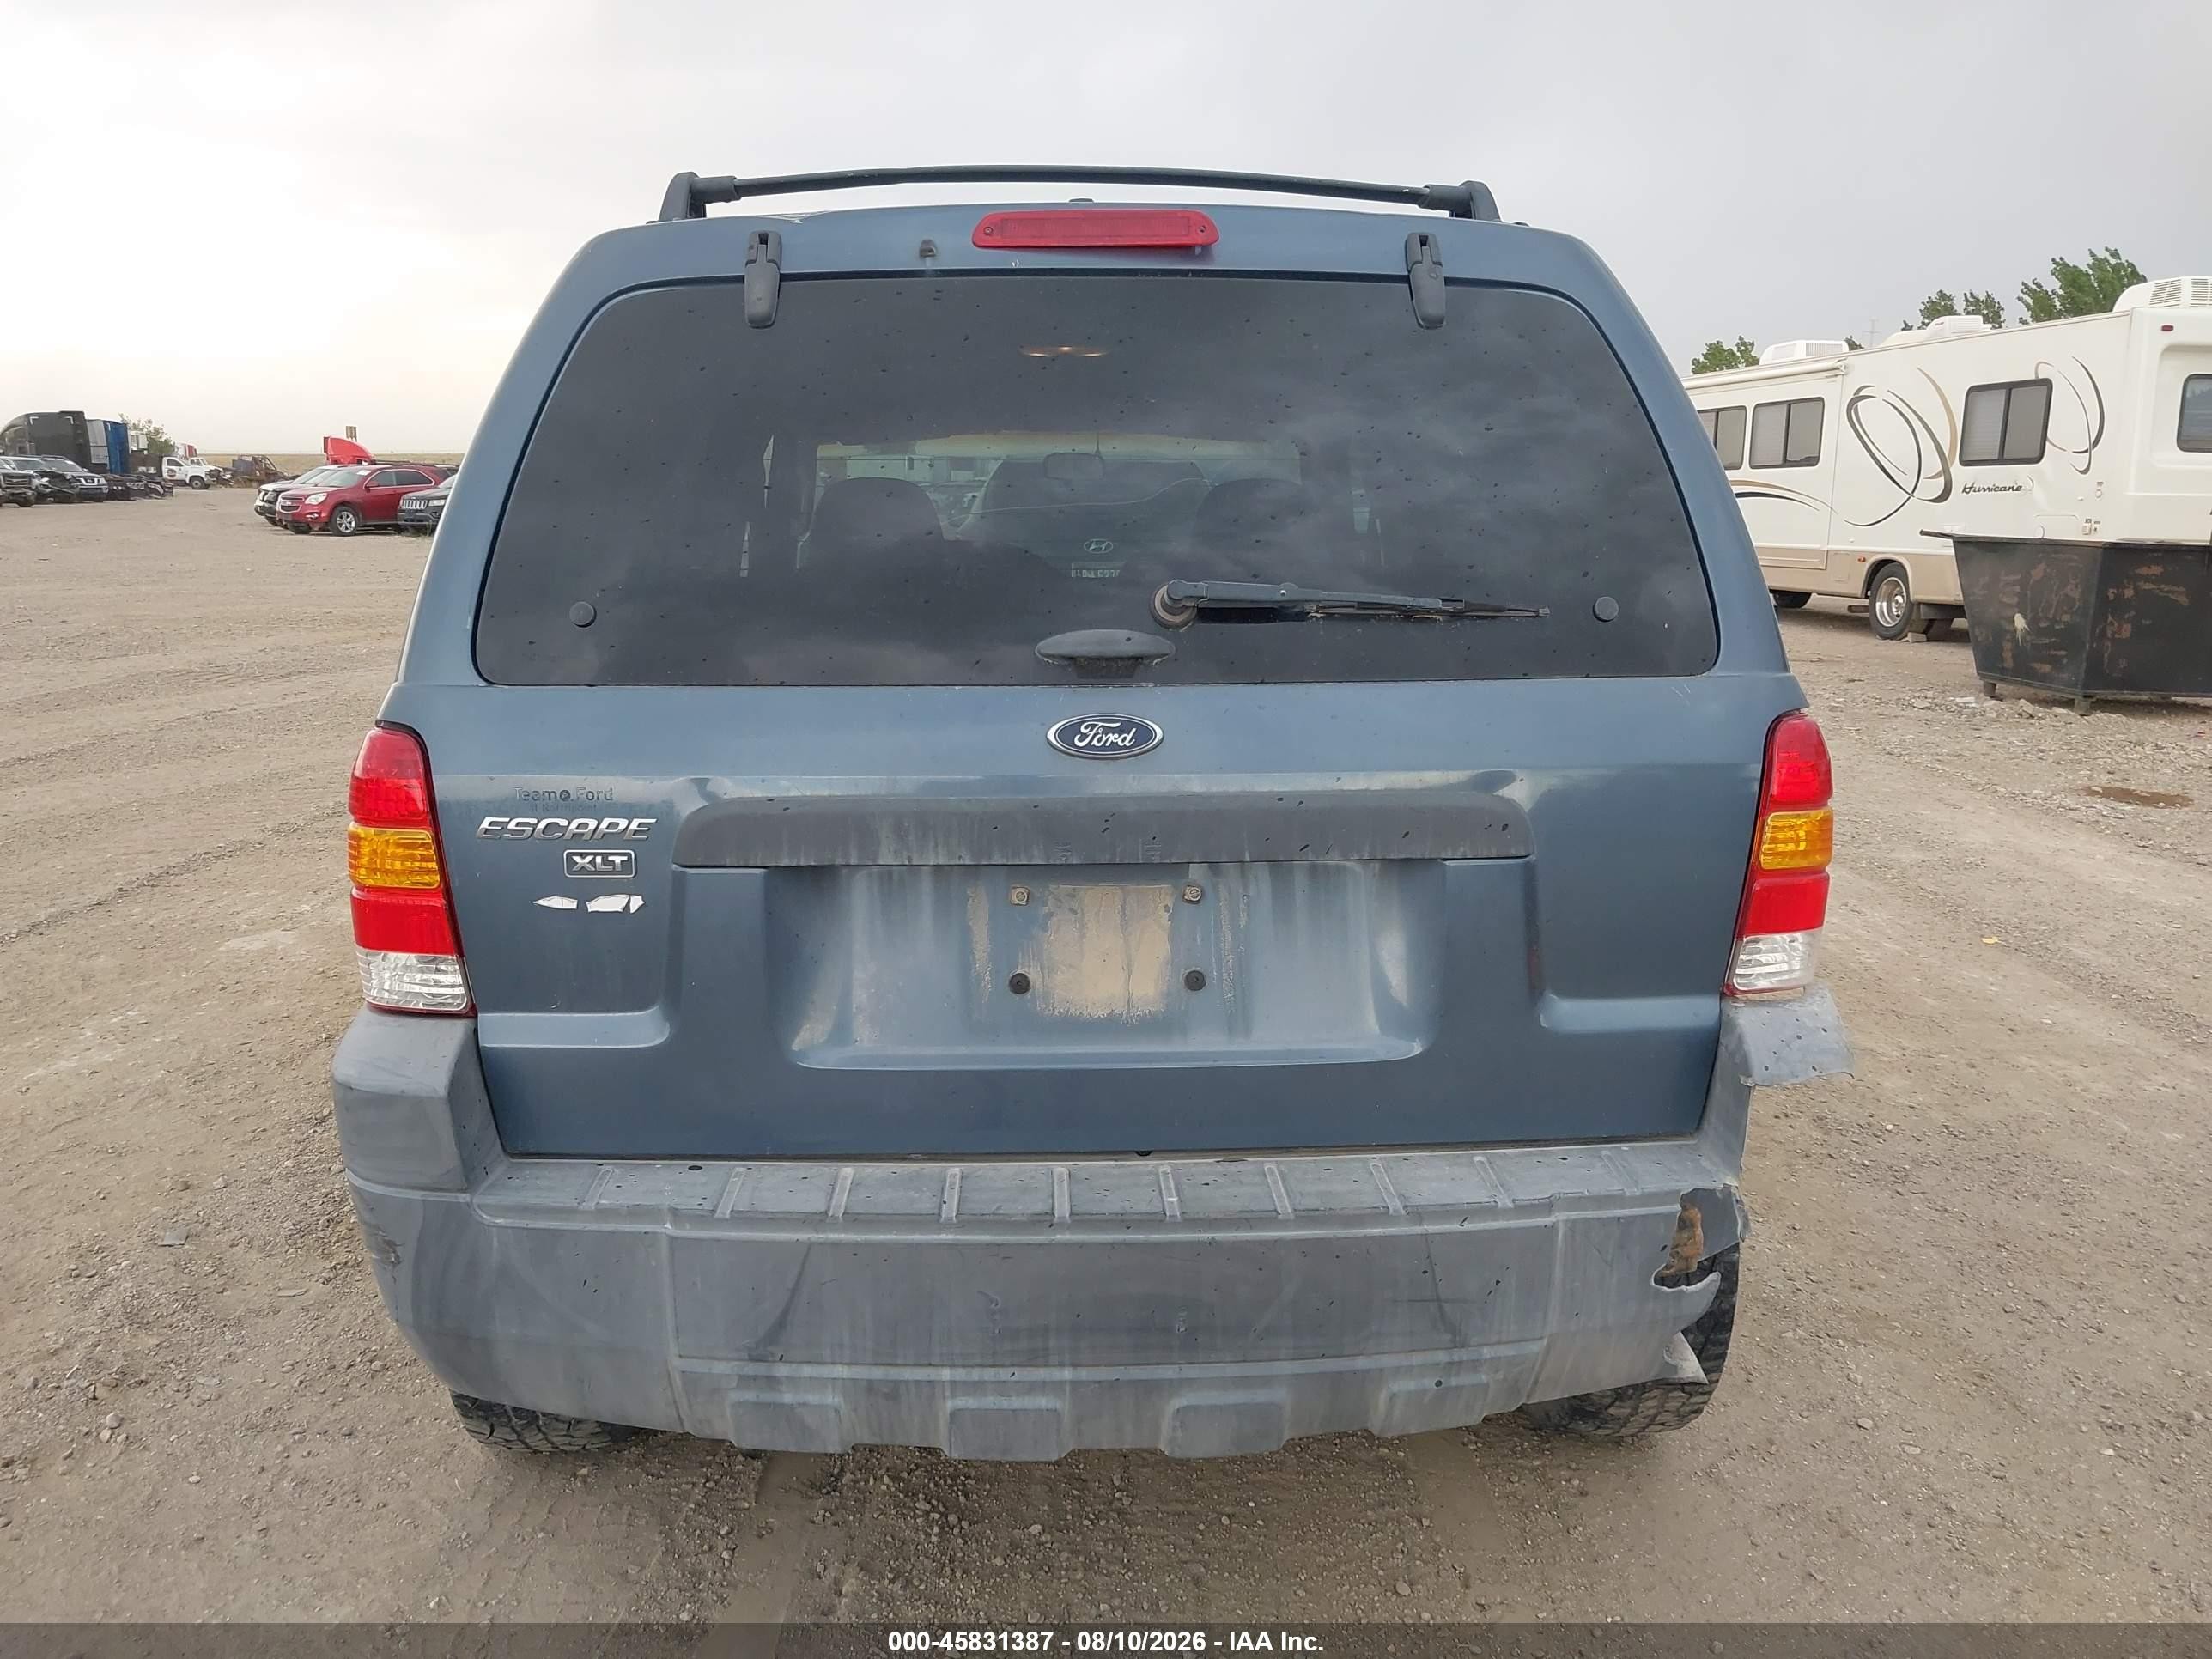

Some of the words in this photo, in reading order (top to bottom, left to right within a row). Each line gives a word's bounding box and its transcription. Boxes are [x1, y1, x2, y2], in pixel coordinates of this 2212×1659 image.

[1961, 481, 2023, 495] Hurricane
[1074, 720, 1138, 747] Ford
[514, 787, 557, 801] Team
[476, 817, 658, 840] ESCAPE
[571, 855, 629, 872] XLT
